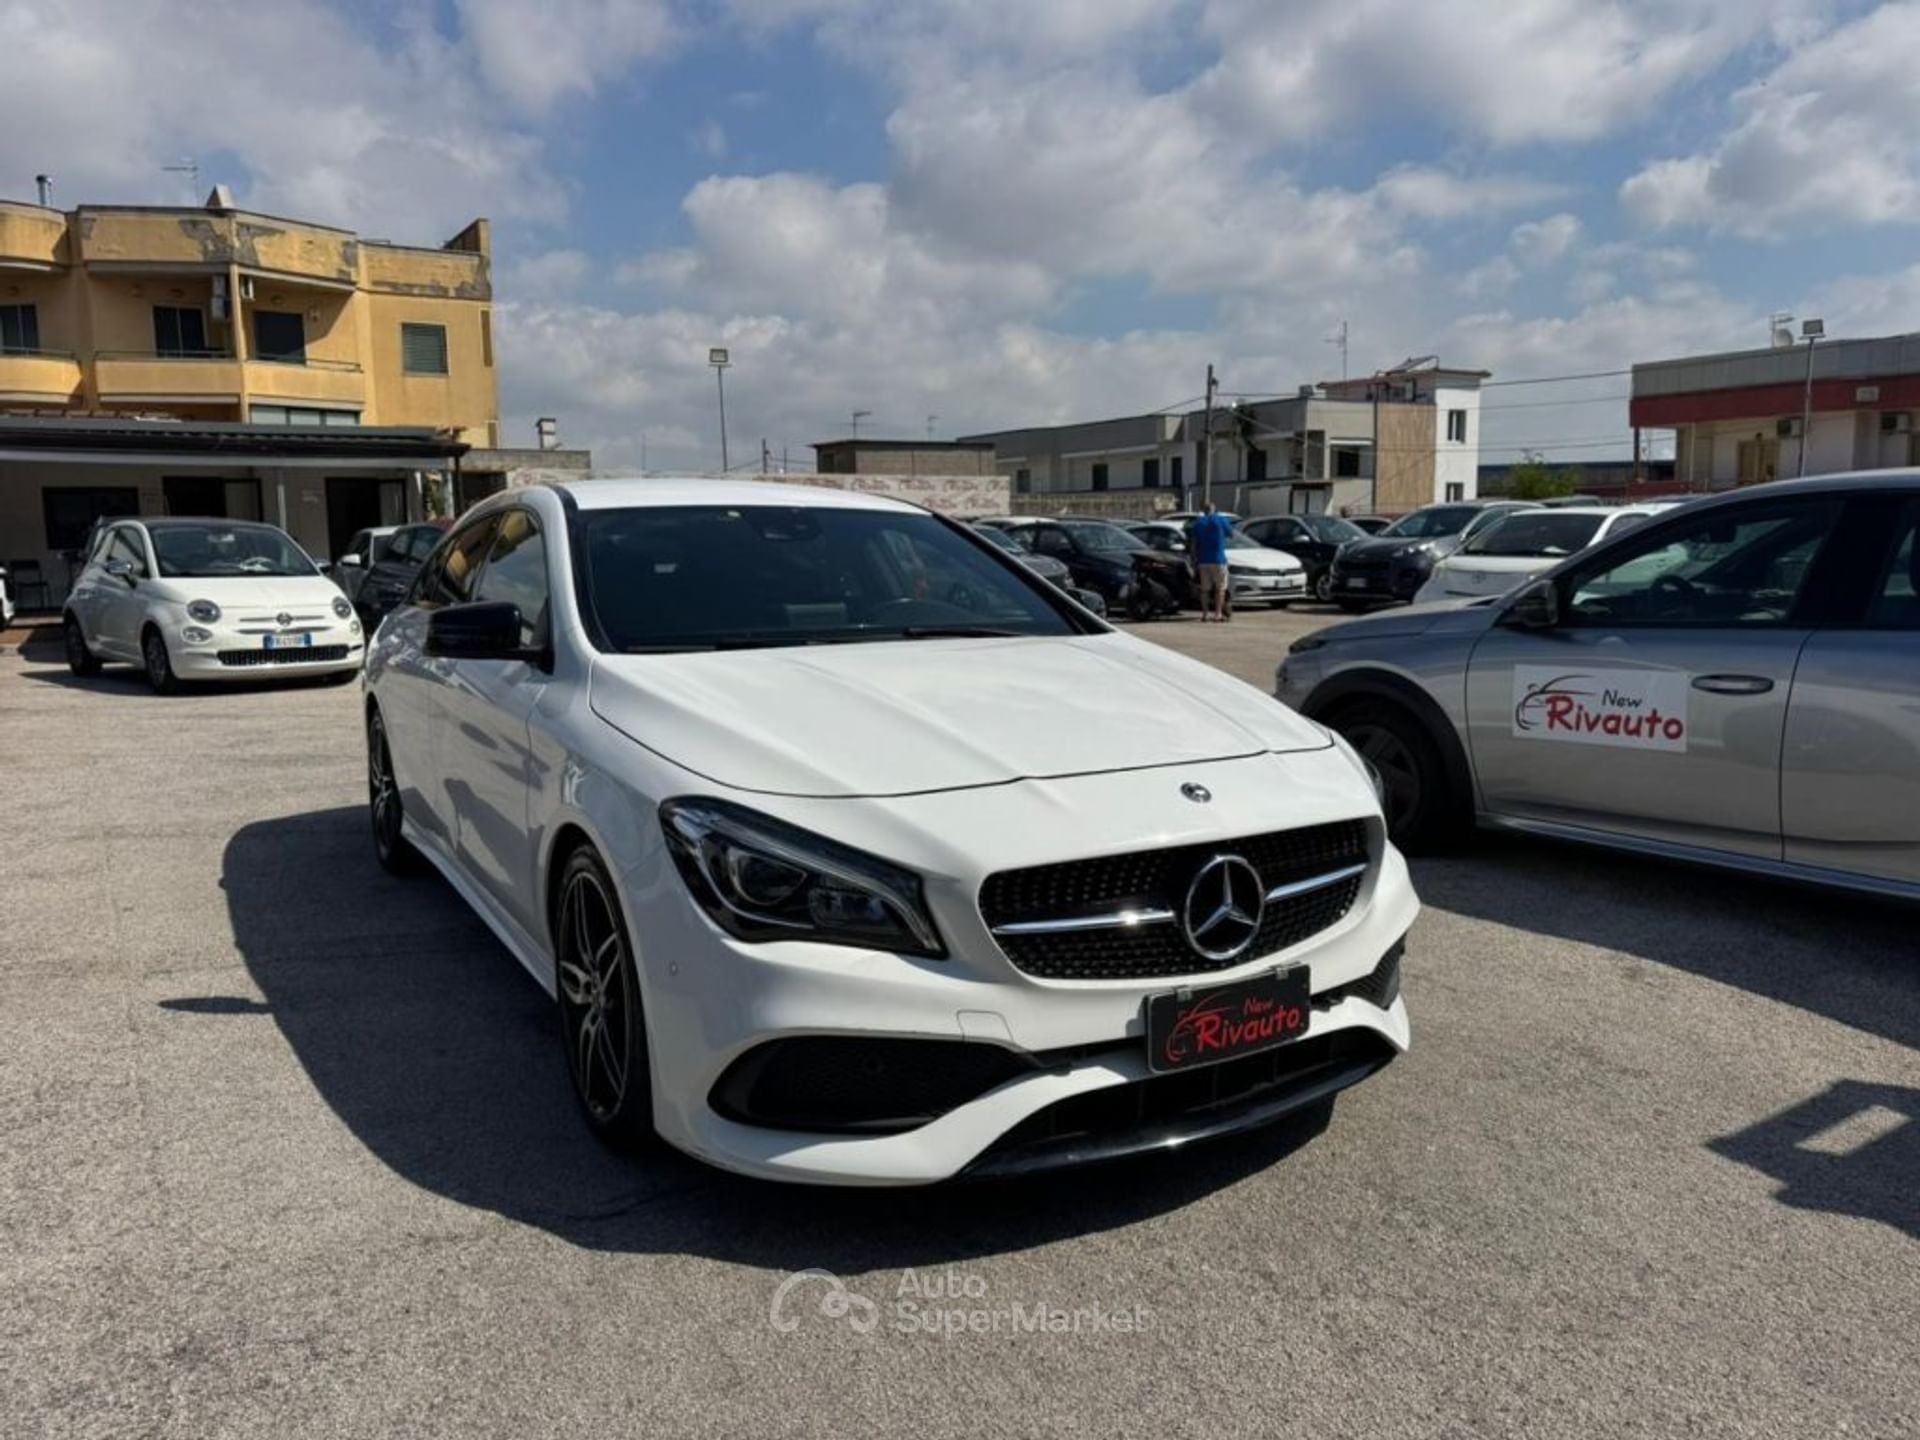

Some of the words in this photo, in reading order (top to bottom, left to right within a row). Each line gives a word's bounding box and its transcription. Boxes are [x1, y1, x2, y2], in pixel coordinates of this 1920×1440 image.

[1602, 689, 1643, 708] New
[1546, 695, 1684, 740] Rivauto
[1243, 998, 1274, 1016] New
[1194, 1006, 1300, 1052] Rivauto
